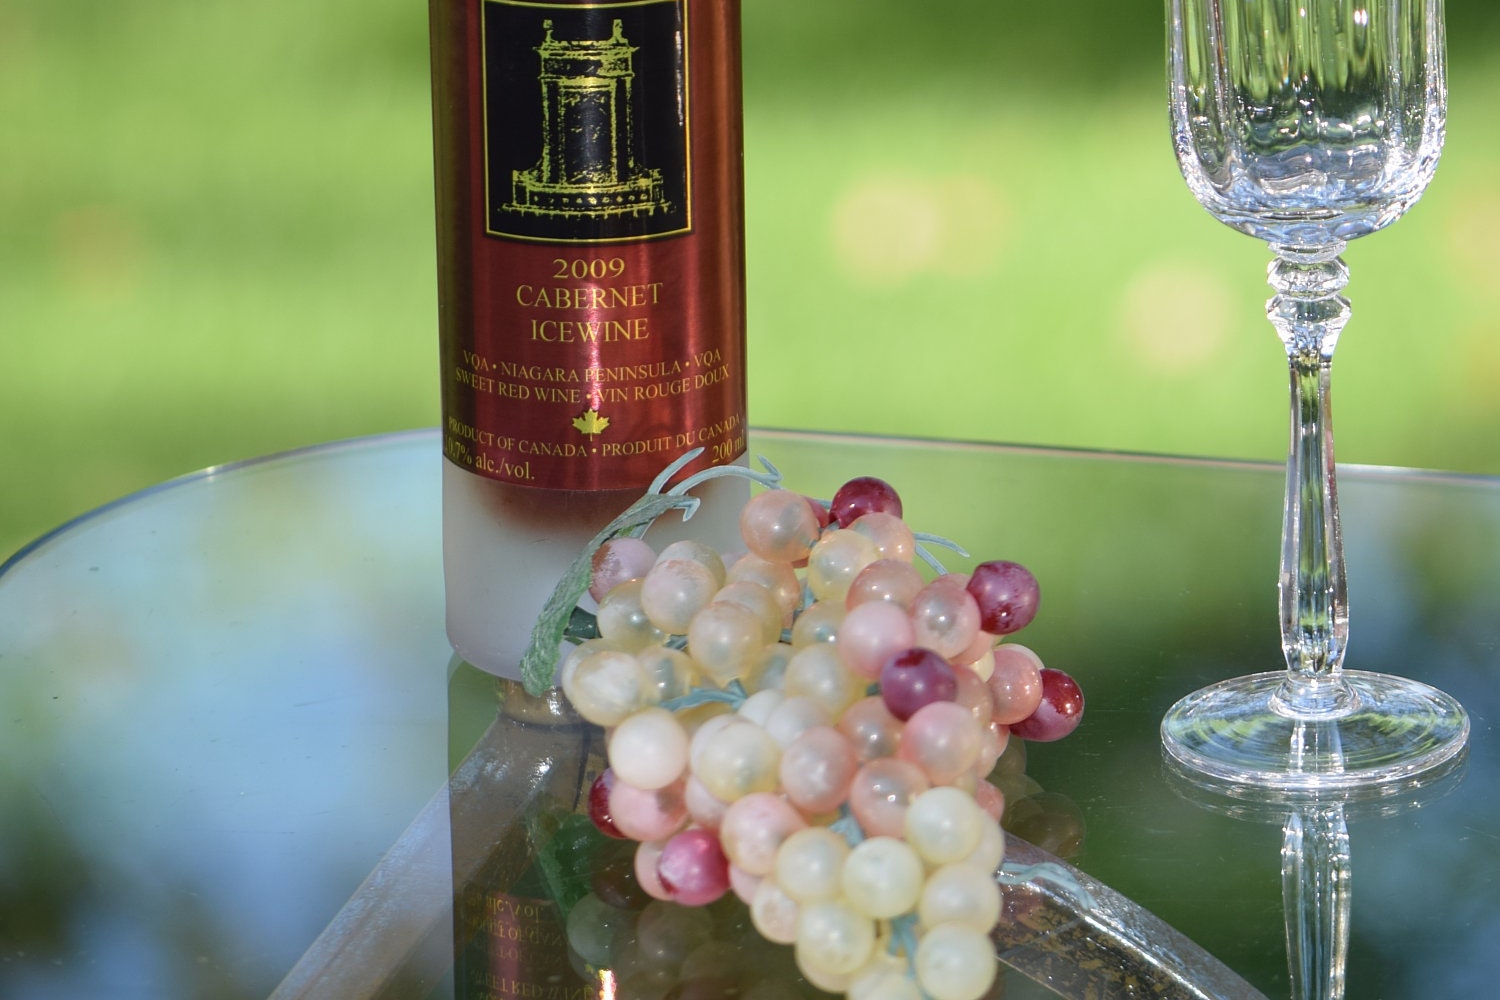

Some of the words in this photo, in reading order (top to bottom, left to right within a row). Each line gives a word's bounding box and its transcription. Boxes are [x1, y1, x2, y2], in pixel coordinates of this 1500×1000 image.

[552, 257, 625, 279] 2009
[516, 282, 663, 310] CABERNET
[530, 317, 650, 344] ICEWINE
[463, 349, 489, 371] VQA
[500, 361, 580, 383] NIAGARA
[584, 360, 681, 383] PENINSULA
[694, 348, 721, 368] VQA
[456, 366, 495, 393] SWEET
[498, 381, 530, 400] RED
[534, 386, 580, 404] WINE
[597, 387, 628, 403] VIN
[634, 377, 691, 401] ROUGE
[694, 363, 730, 390] DOUX
[448, 416, 494, 447] PRODUCT
[497, 435, 516, 451] OF
[518, 439, 588, 457] CANADA
[602, 436, 672, 457] PRODUIT
[676, 431, 695, 448] DU
[698, 412, 740, 441] CANADA
[712, 438, 733, 463] 200
[475, 452, 535, 480] alc./vol.
